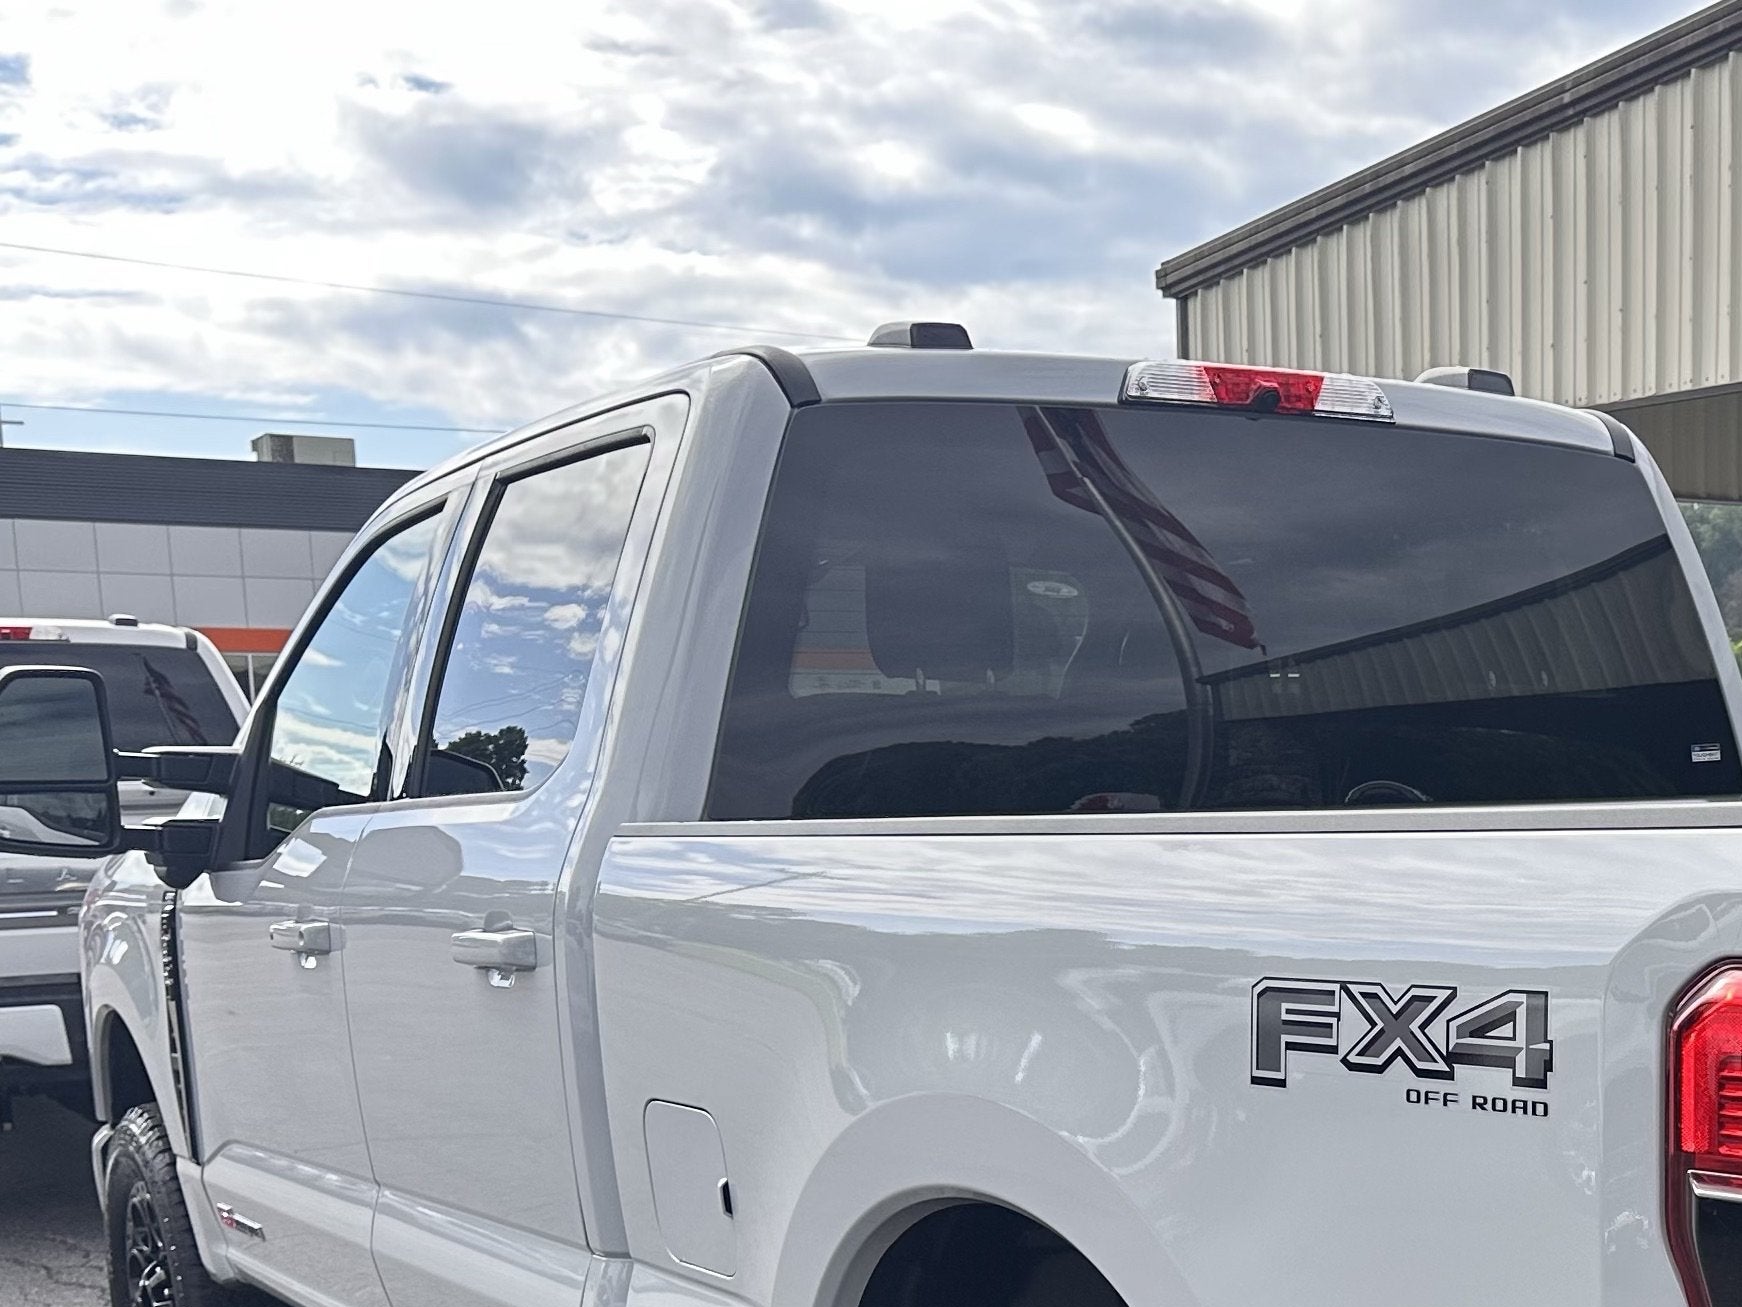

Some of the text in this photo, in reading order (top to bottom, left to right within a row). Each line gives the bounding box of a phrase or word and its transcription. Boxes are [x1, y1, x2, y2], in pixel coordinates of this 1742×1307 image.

[1250, 976, 1554, 1089] FX4
[1405, 1088, 1550, 1118] OFF ROAD
